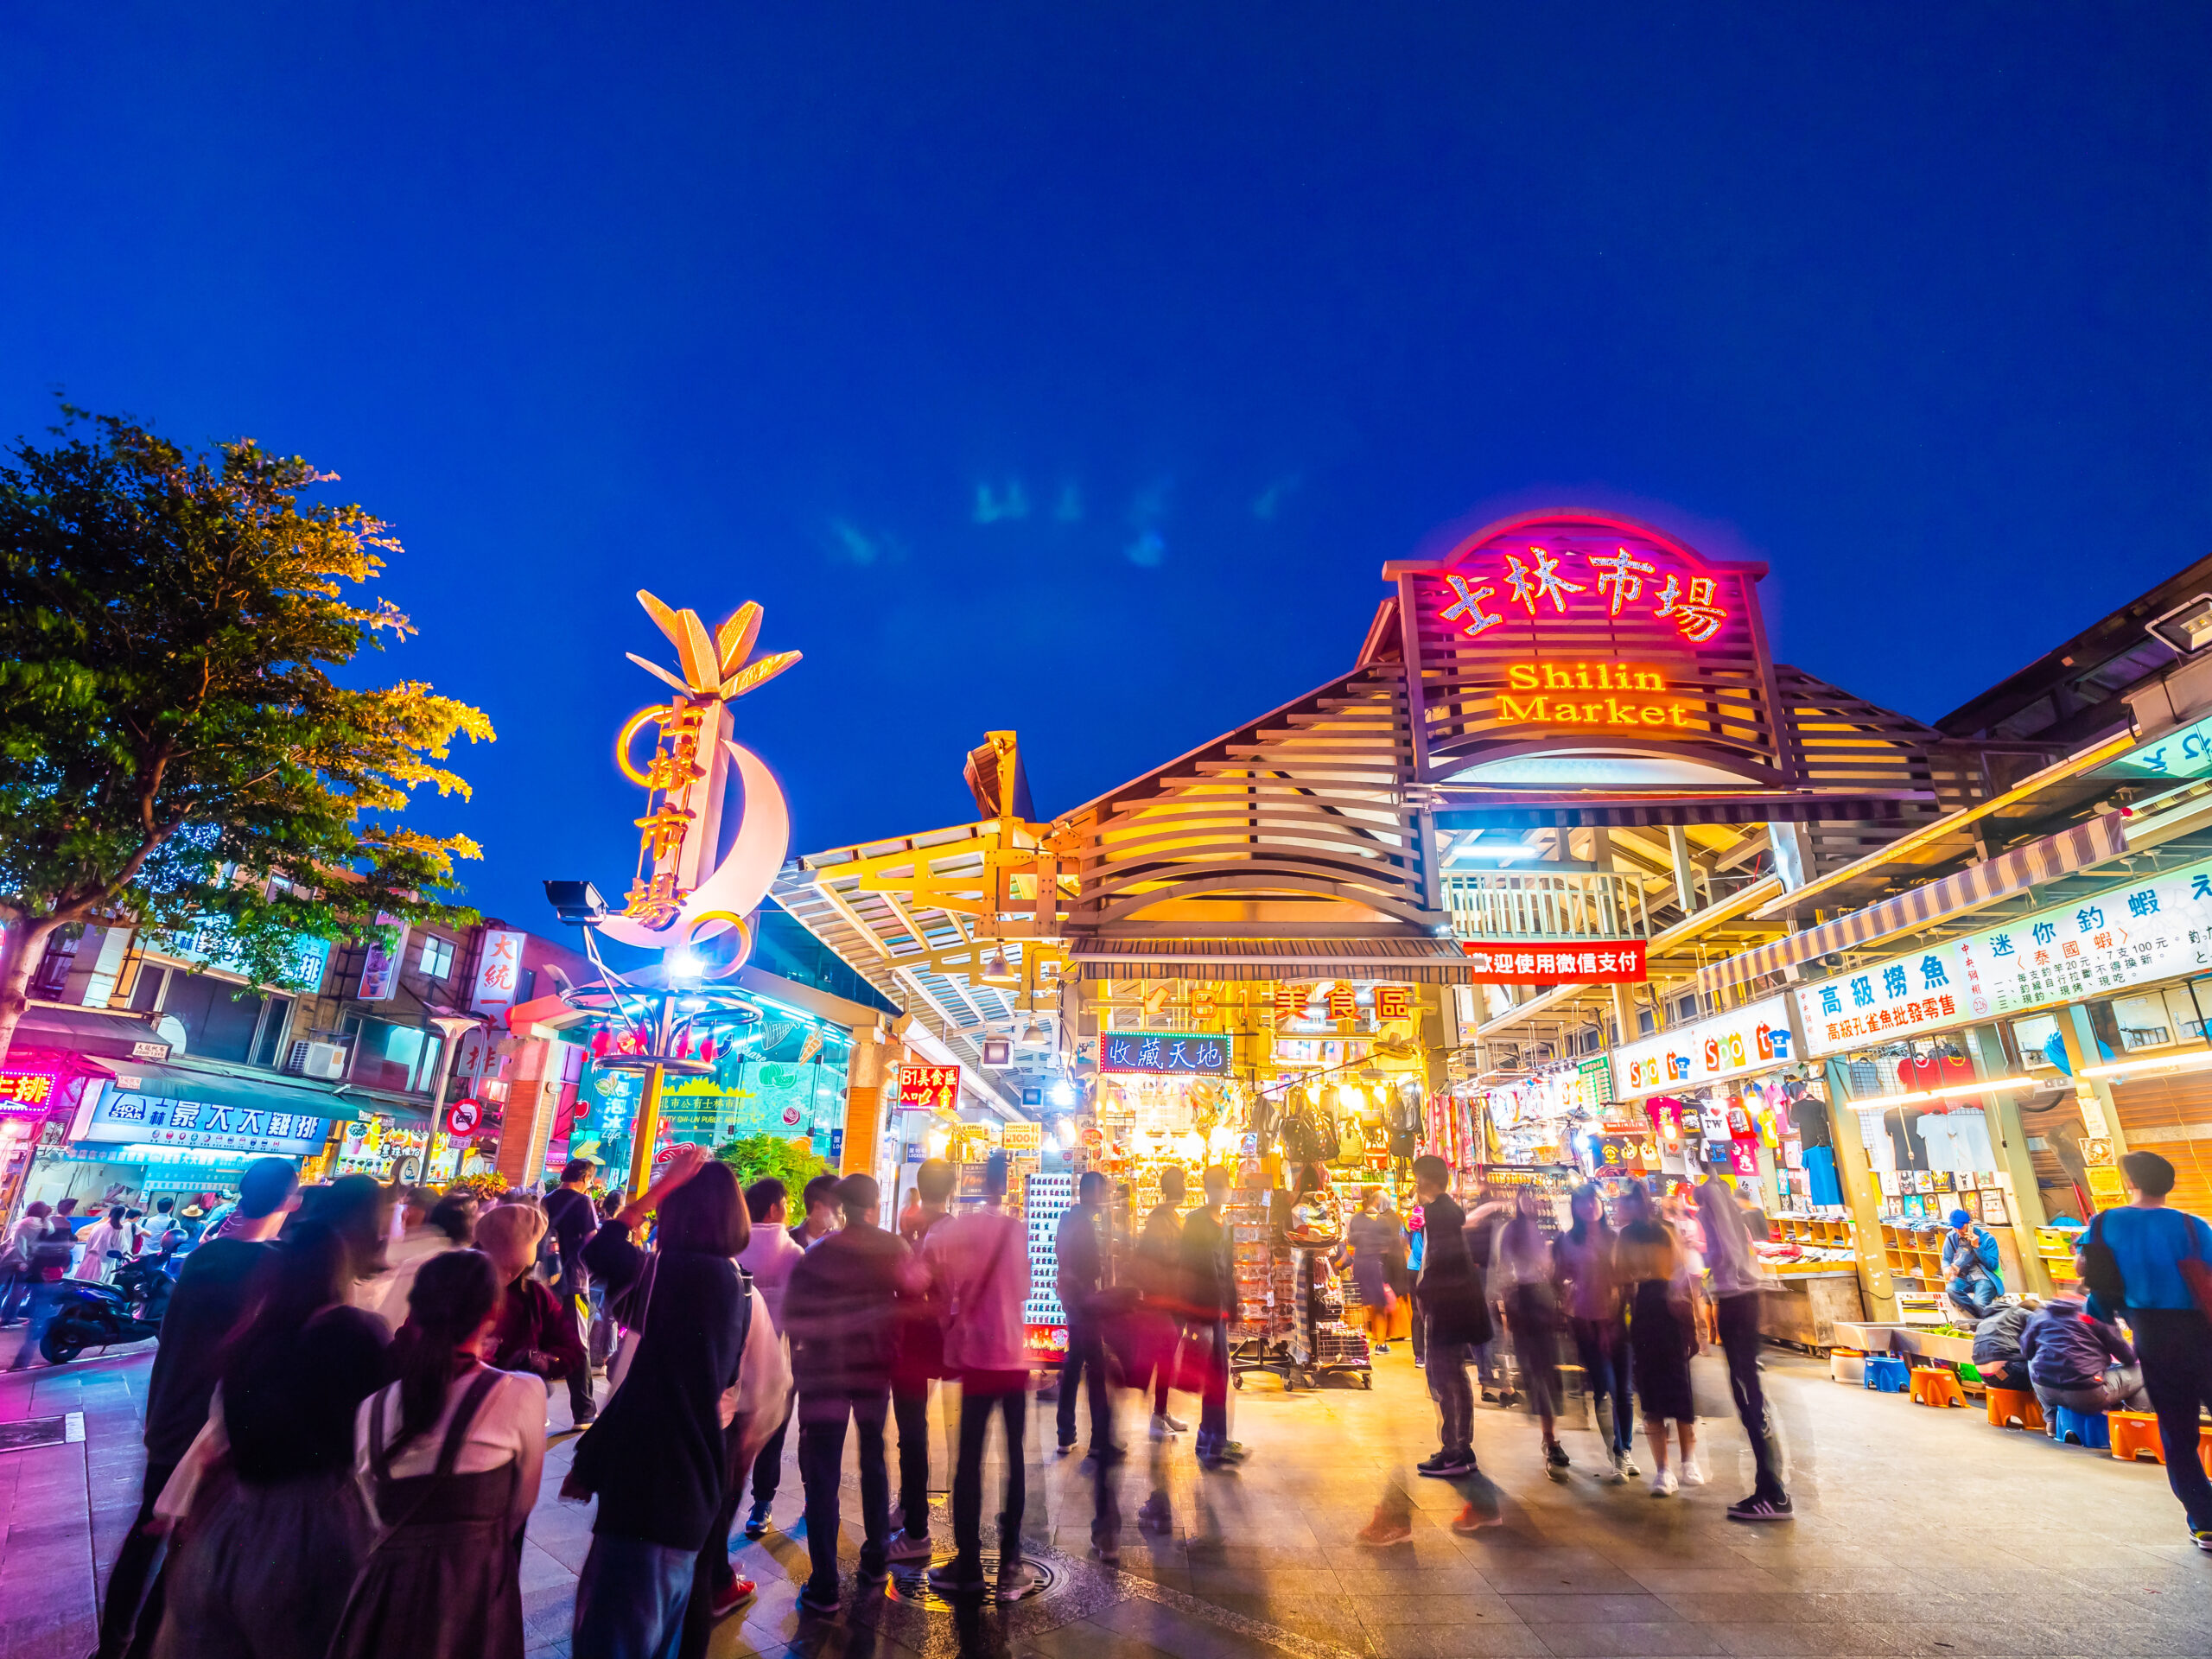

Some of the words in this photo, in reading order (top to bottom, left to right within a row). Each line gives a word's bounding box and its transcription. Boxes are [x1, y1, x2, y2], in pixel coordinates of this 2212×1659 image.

[1440, 546, 1727, 643] 士林市場
[1509, 663, 1667, 691] Shilin
[1496, 694, 1688, 728] Market
[621, 695, 706, 930] 士林市場
[1990, 889, 2160, 958] 迷你釣蝦
[1472, 951, 1637, 974] 歡迎使用微信支付
[1818, 955, 1949, 1017] 高級撈魚
[1826, 994, 1956, 1042] 高級孔雀魚批發零售
[1974, 999, 1987, 1011] 226
[1109, 1037, 1223, 1070] 收藏天地
[1706, 1030, 1770, 1070] Spot
[901, 1069, 957, 1087] B1美食區
[1630, 1056, 1677, 1087] Spot
[116, 1104, 140, 1113] HOT
[900, 1091, 918, 1102] 入口
[601, 1128, 621, 1144] Life
[1705, 1118, 1723, 1129] TW
[1012, 1134, 1031, 1143] 100
